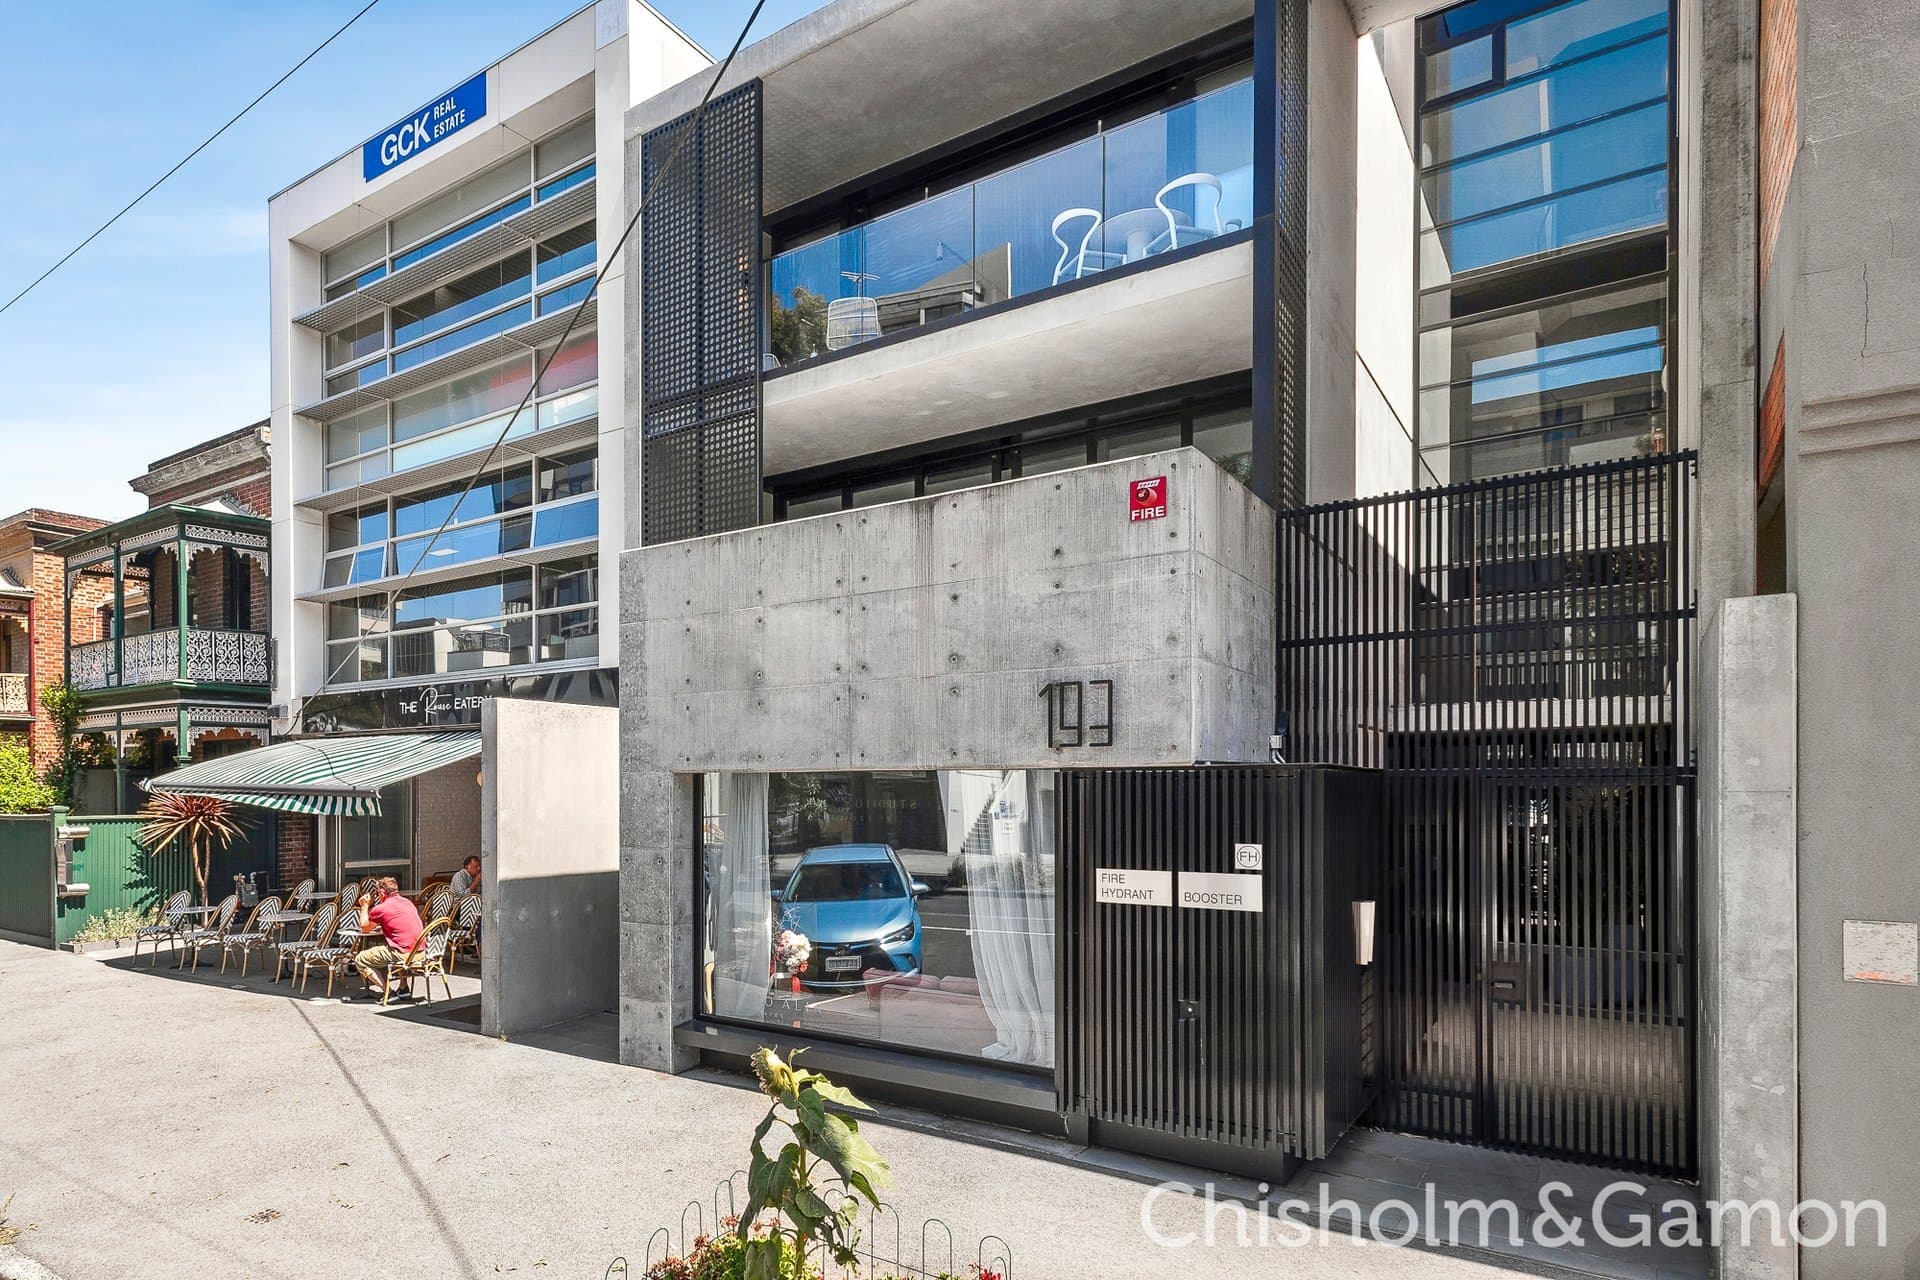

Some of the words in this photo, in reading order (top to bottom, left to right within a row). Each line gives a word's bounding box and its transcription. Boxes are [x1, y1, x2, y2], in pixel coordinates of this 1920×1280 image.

[433, 96, 456, 120] REAL
[433, 109, 466, 139] ESTATE
[380, 111, 431, 166] GCK
[1131, 505, 1165, 521] FIRE
[399, 701, 418, 714] THE
[1239, 851, 1257, 863] FH
[1101, 873, 1126, 885] FIRE
[1101, 888, 1154, 900] HYDRANT
[1184, 892, 1242, 905] BOOSTER
